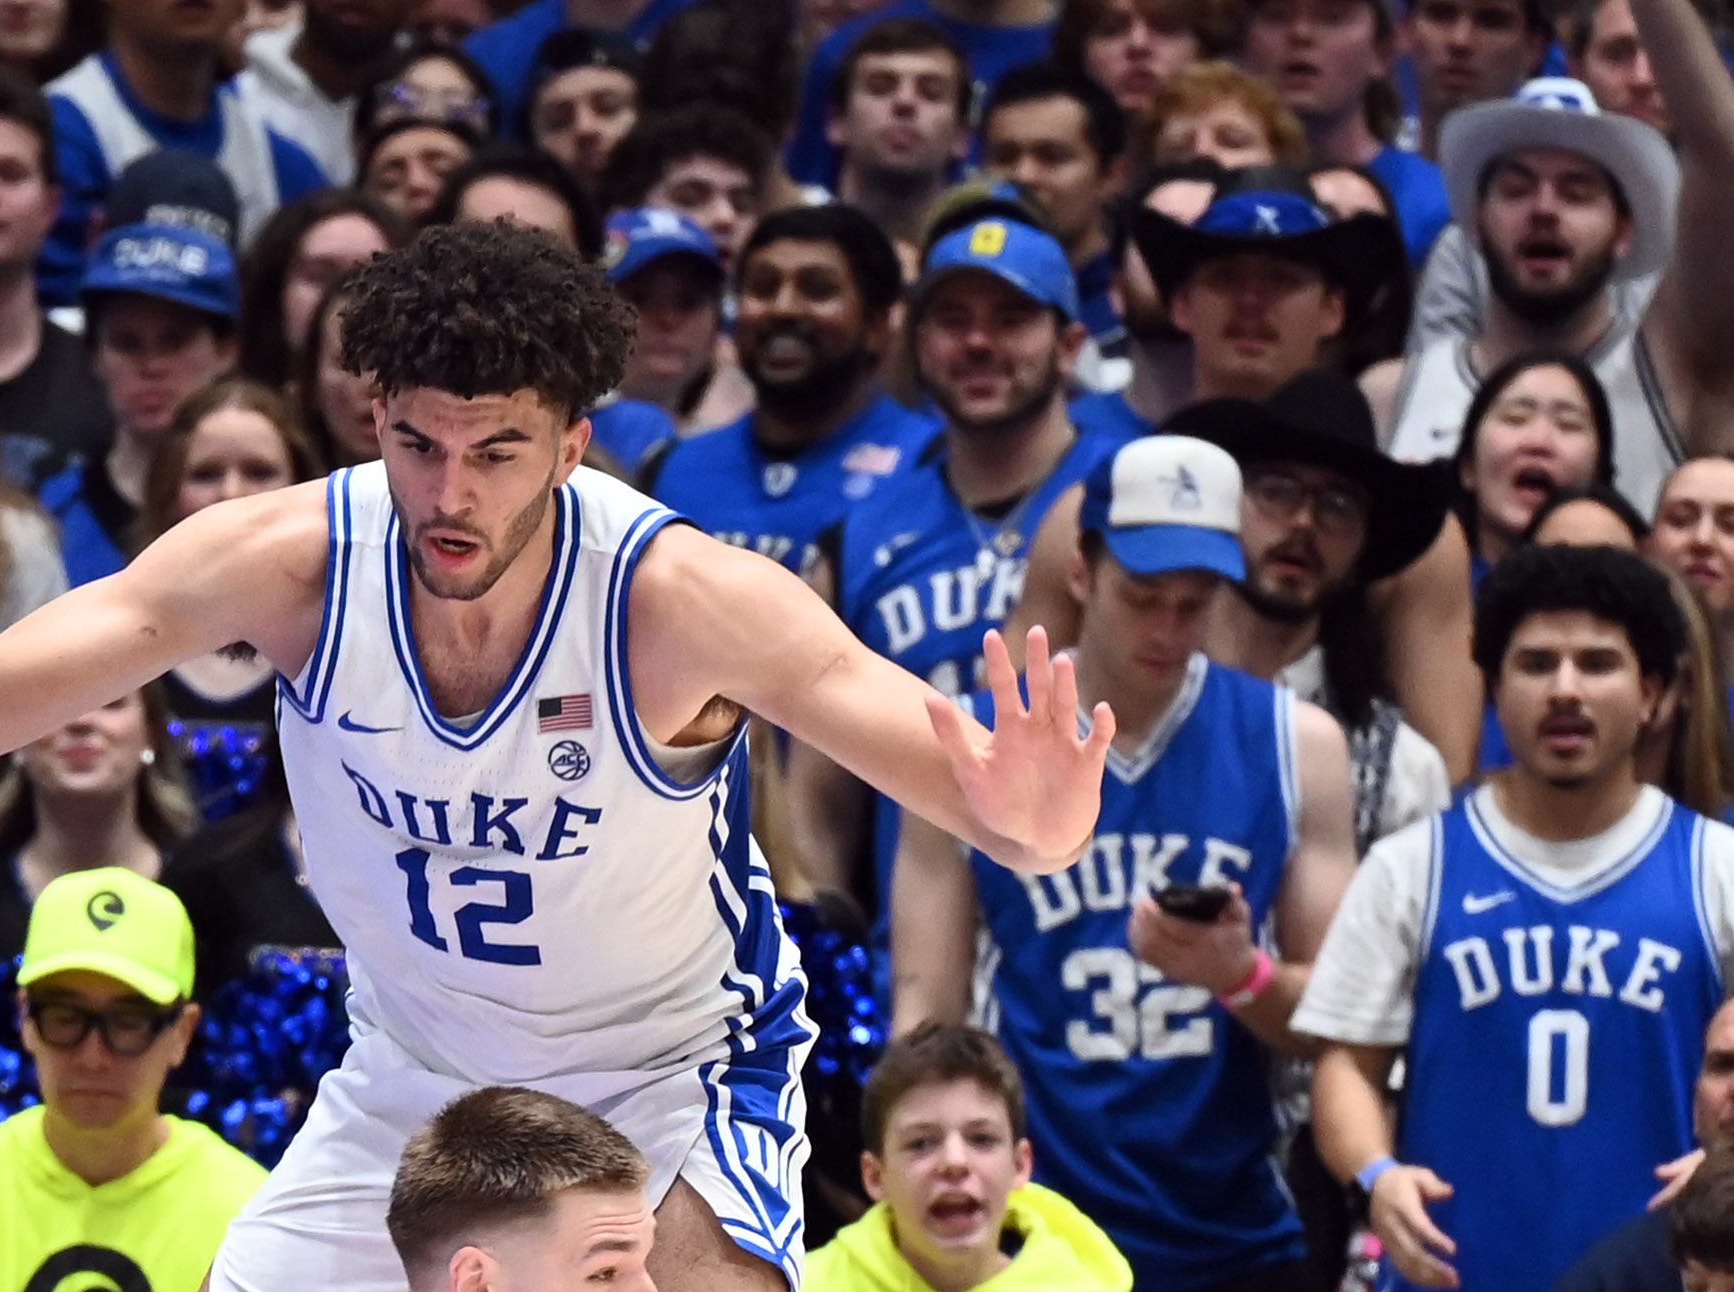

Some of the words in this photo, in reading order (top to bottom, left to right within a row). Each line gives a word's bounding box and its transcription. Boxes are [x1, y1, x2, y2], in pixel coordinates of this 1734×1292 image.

[877, 557, 1029, 653] DUK
[341, 758, 602, 860] DUKE
[395, 847, 542, 966] 12
[1061, 947, 1214, 1062] 32
[1443, 924, 1682, 1013] DUKE
[1526, 1008, 1590, 1128] 0
